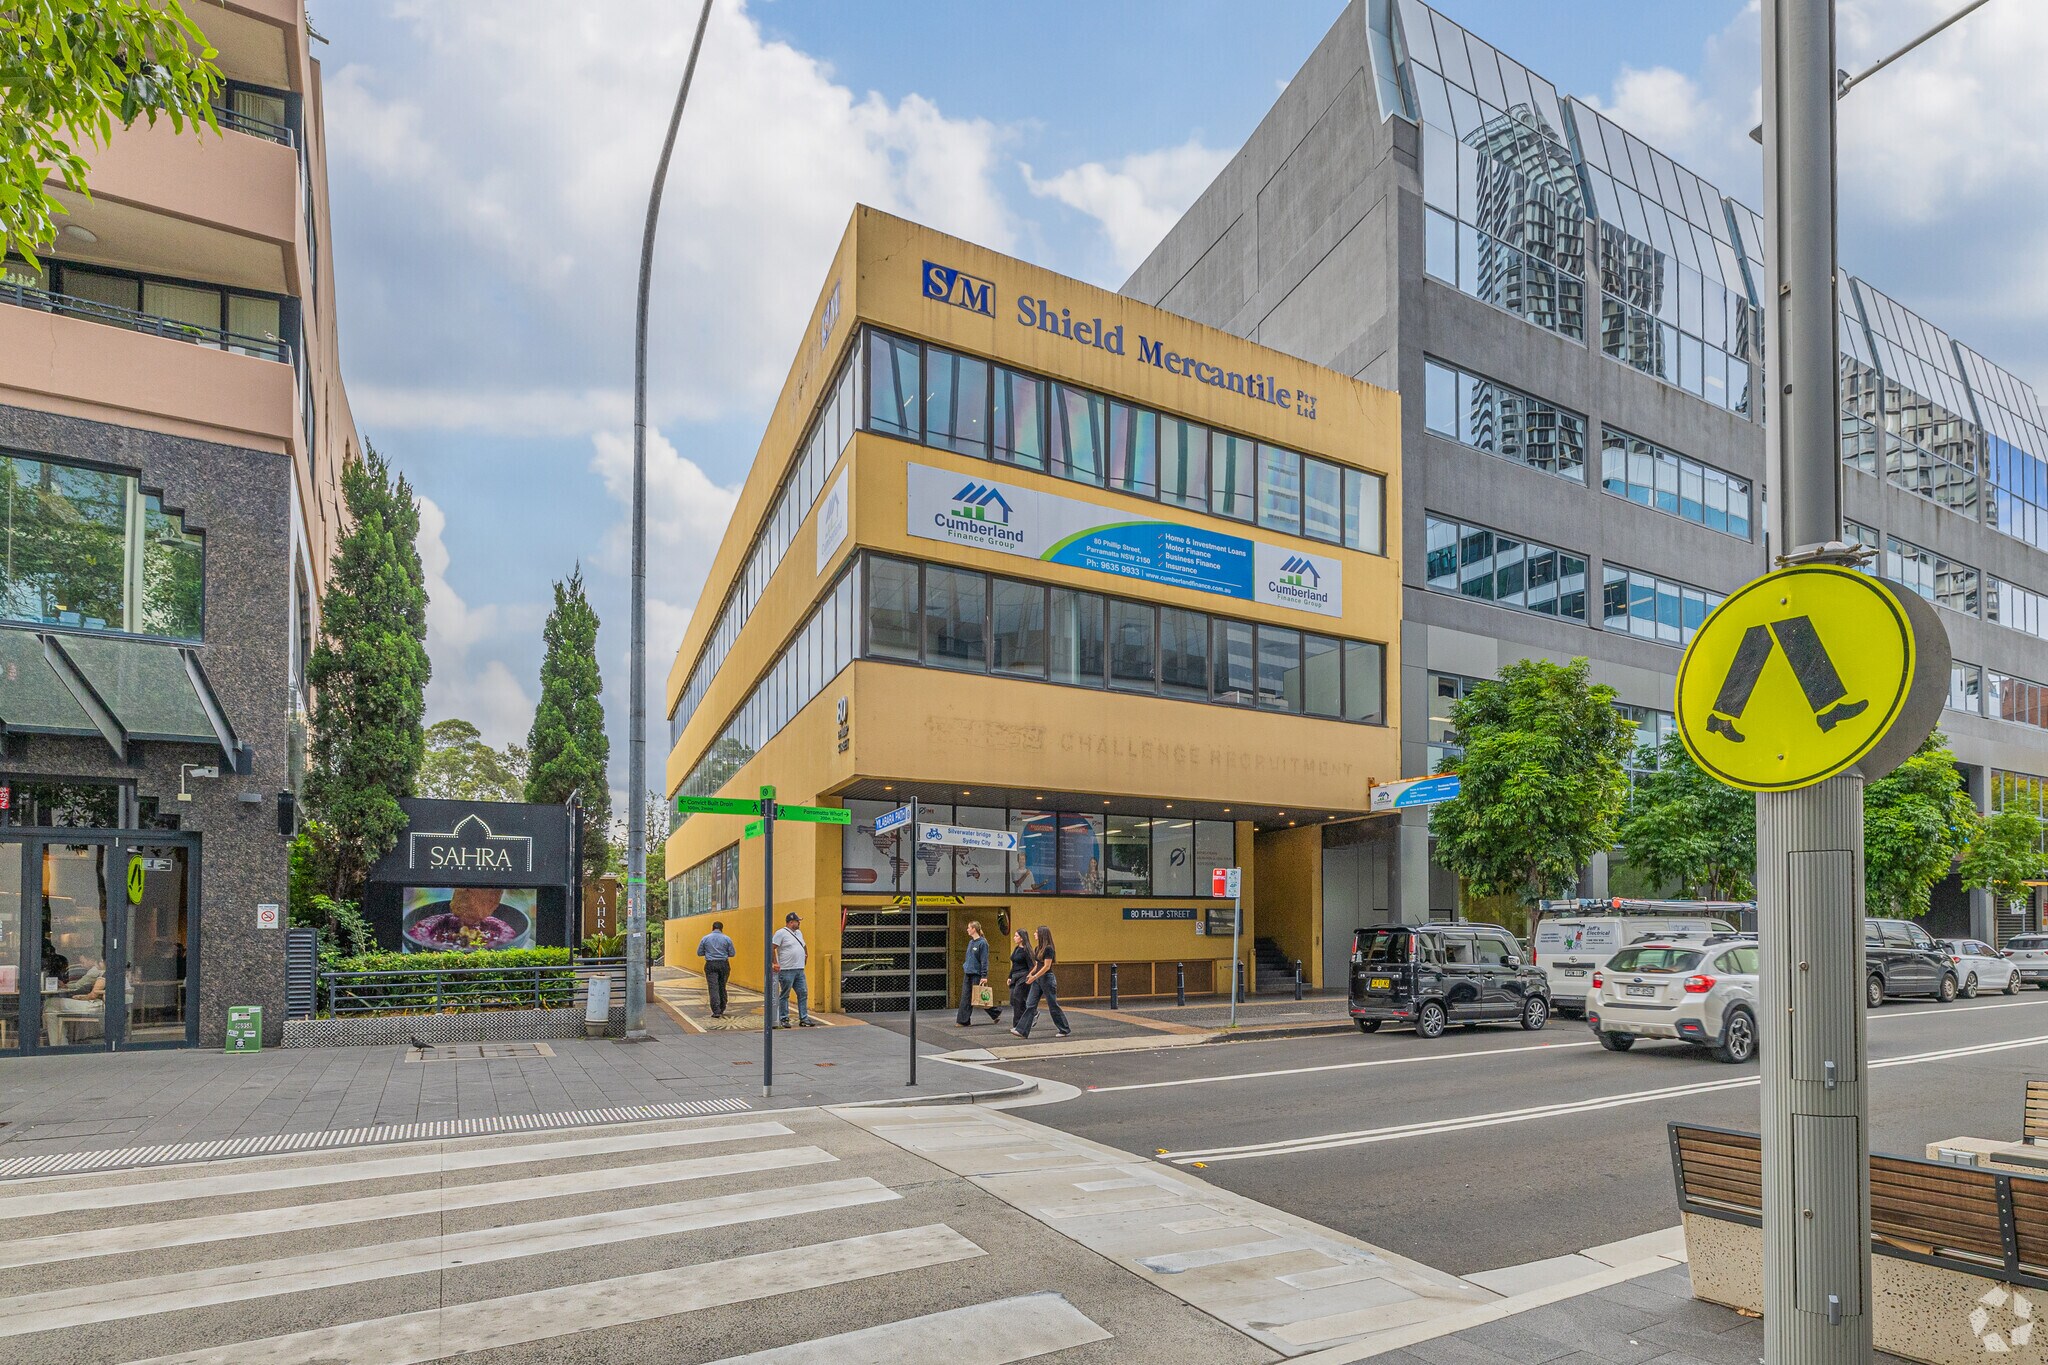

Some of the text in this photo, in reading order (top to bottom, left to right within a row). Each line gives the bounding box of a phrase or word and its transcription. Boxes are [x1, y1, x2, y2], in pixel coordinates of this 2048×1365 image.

[1016, 294, 1292, 409] Shield Mercantile
[1296, 388, 1317, 408] Pty
[1296, 404, 1317, 420] Ltd
[934, 513, 1024, 542] Cumberland
[948, 530, 1015, 550] Finance Group
[1103, 539, 1121, 551] Phillip
[1166, 533, 1184, 544] Home
[1192, 539, 1227, 553] Investment
[1228, 547, 1246, 557] Loans
[1086, 546, 1150, 564] Parramatta NSW 2150
[1166, 543, 1211, 558] Motor Finance
[1086, 558, 1140, 576] Ph: 9635 9933
[1166, 552, 1221, 570] Business Finance
[1166, 562, 1197, 574] Insurance
[1145, 572, 1231, 594] www.cumberlandfinance.com.au
[1268, 581, 1328, 602] Cumberland
[1277, 594, 1322, 608] Finance Group
[948, 828, 975, 836] Silverwater
[430, 846, 512, 867] SAHRA
[1130, 910, 1190, 918] 80 PHILLIP STREET
